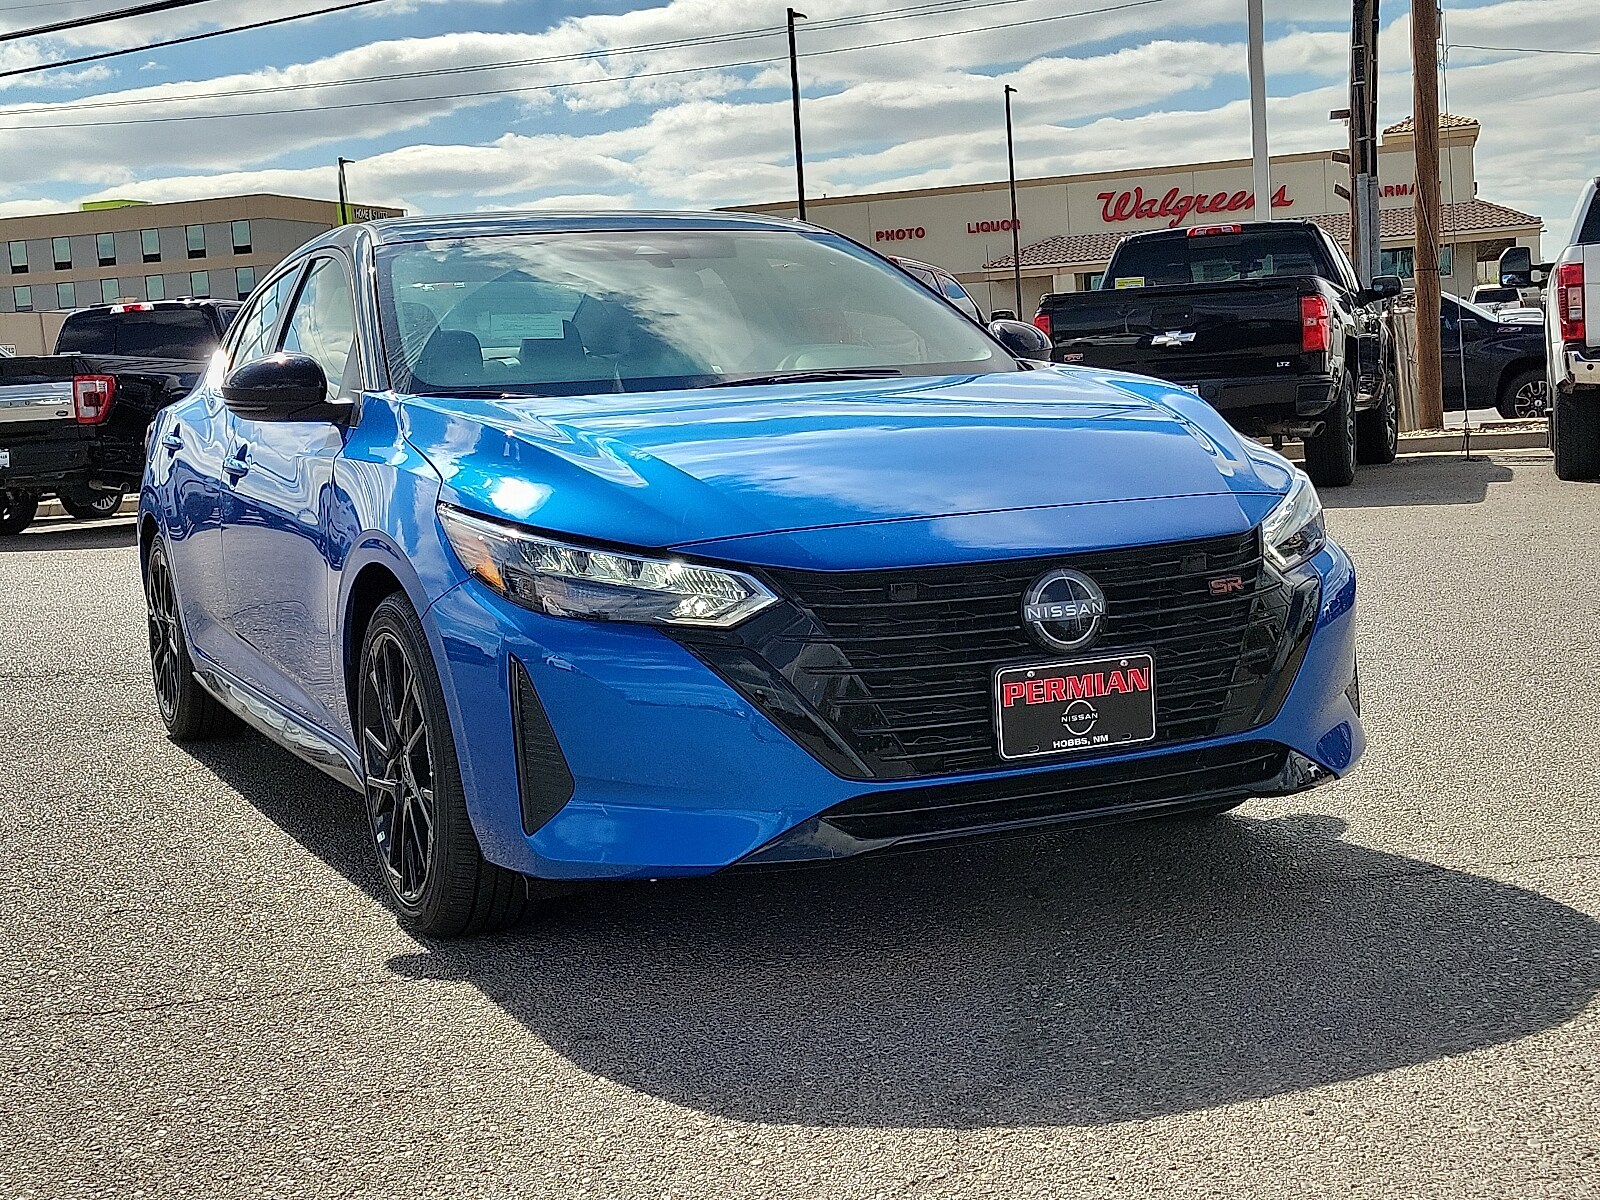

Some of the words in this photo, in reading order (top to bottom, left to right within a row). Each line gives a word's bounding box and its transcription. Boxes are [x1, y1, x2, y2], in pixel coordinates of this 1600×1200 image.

[875, 227, 926, 242] PHOTO
[1210, 575, 1244, 594] SR
[1026, 602, 1104, 620] NISSAN
[1003, 667, 1150, 707] PERMIAN
[1061, 712, 1099, 723] NISSAN
[1052, 737, 1091, 749] HOBBS,
[1093, 734, 1109, 744] NM
